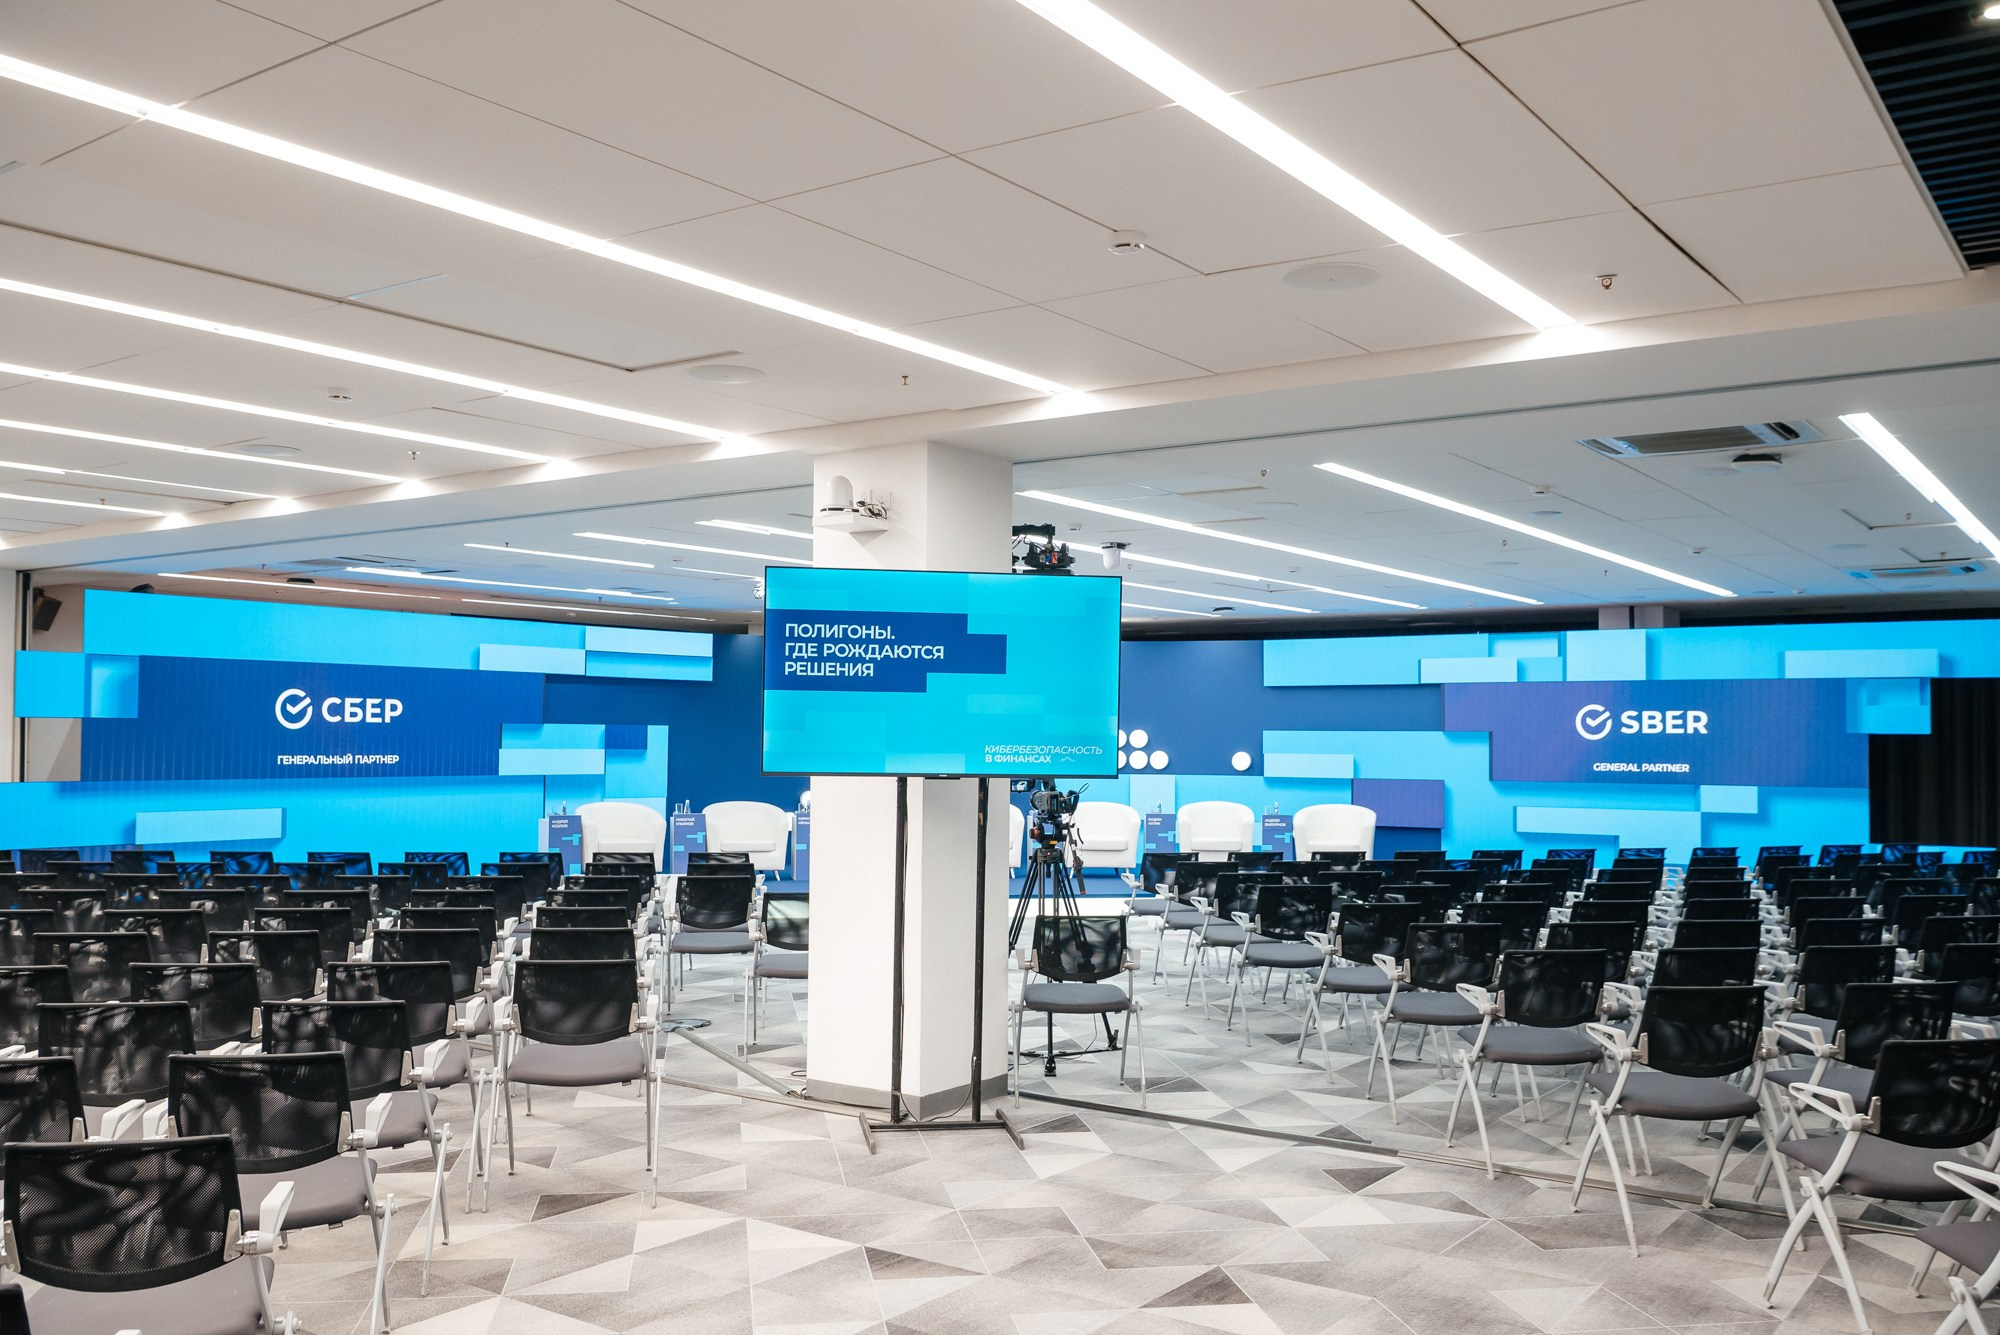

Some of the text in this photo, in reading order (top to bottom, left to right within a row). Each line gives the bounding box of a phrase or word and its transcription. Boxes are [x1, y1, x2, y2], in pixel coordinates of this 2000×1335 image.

[785, 623, 896, 640] ПОЛИГОНЫ.
[785, 642, 945, 661] ГДЕ РОЖДАЮТСЯ
[784, 661, 875, 677] РЕШЕНИЯ
[321, 696, 404, 724] СБЕР
[1620, 710, 1709, 735] SBER
[984, 744, 1103, 755] КИБЕРБЕЗОПАСНОСТЬ
[277, 752, 400, 765] ГЕНЕРАЛЬНЫЙ ПАРТНЕР
[985, 754, 1052, 764] В ФИНАНСАХ
[1593, 762, 1690, 773] GENERAL PARTNER
